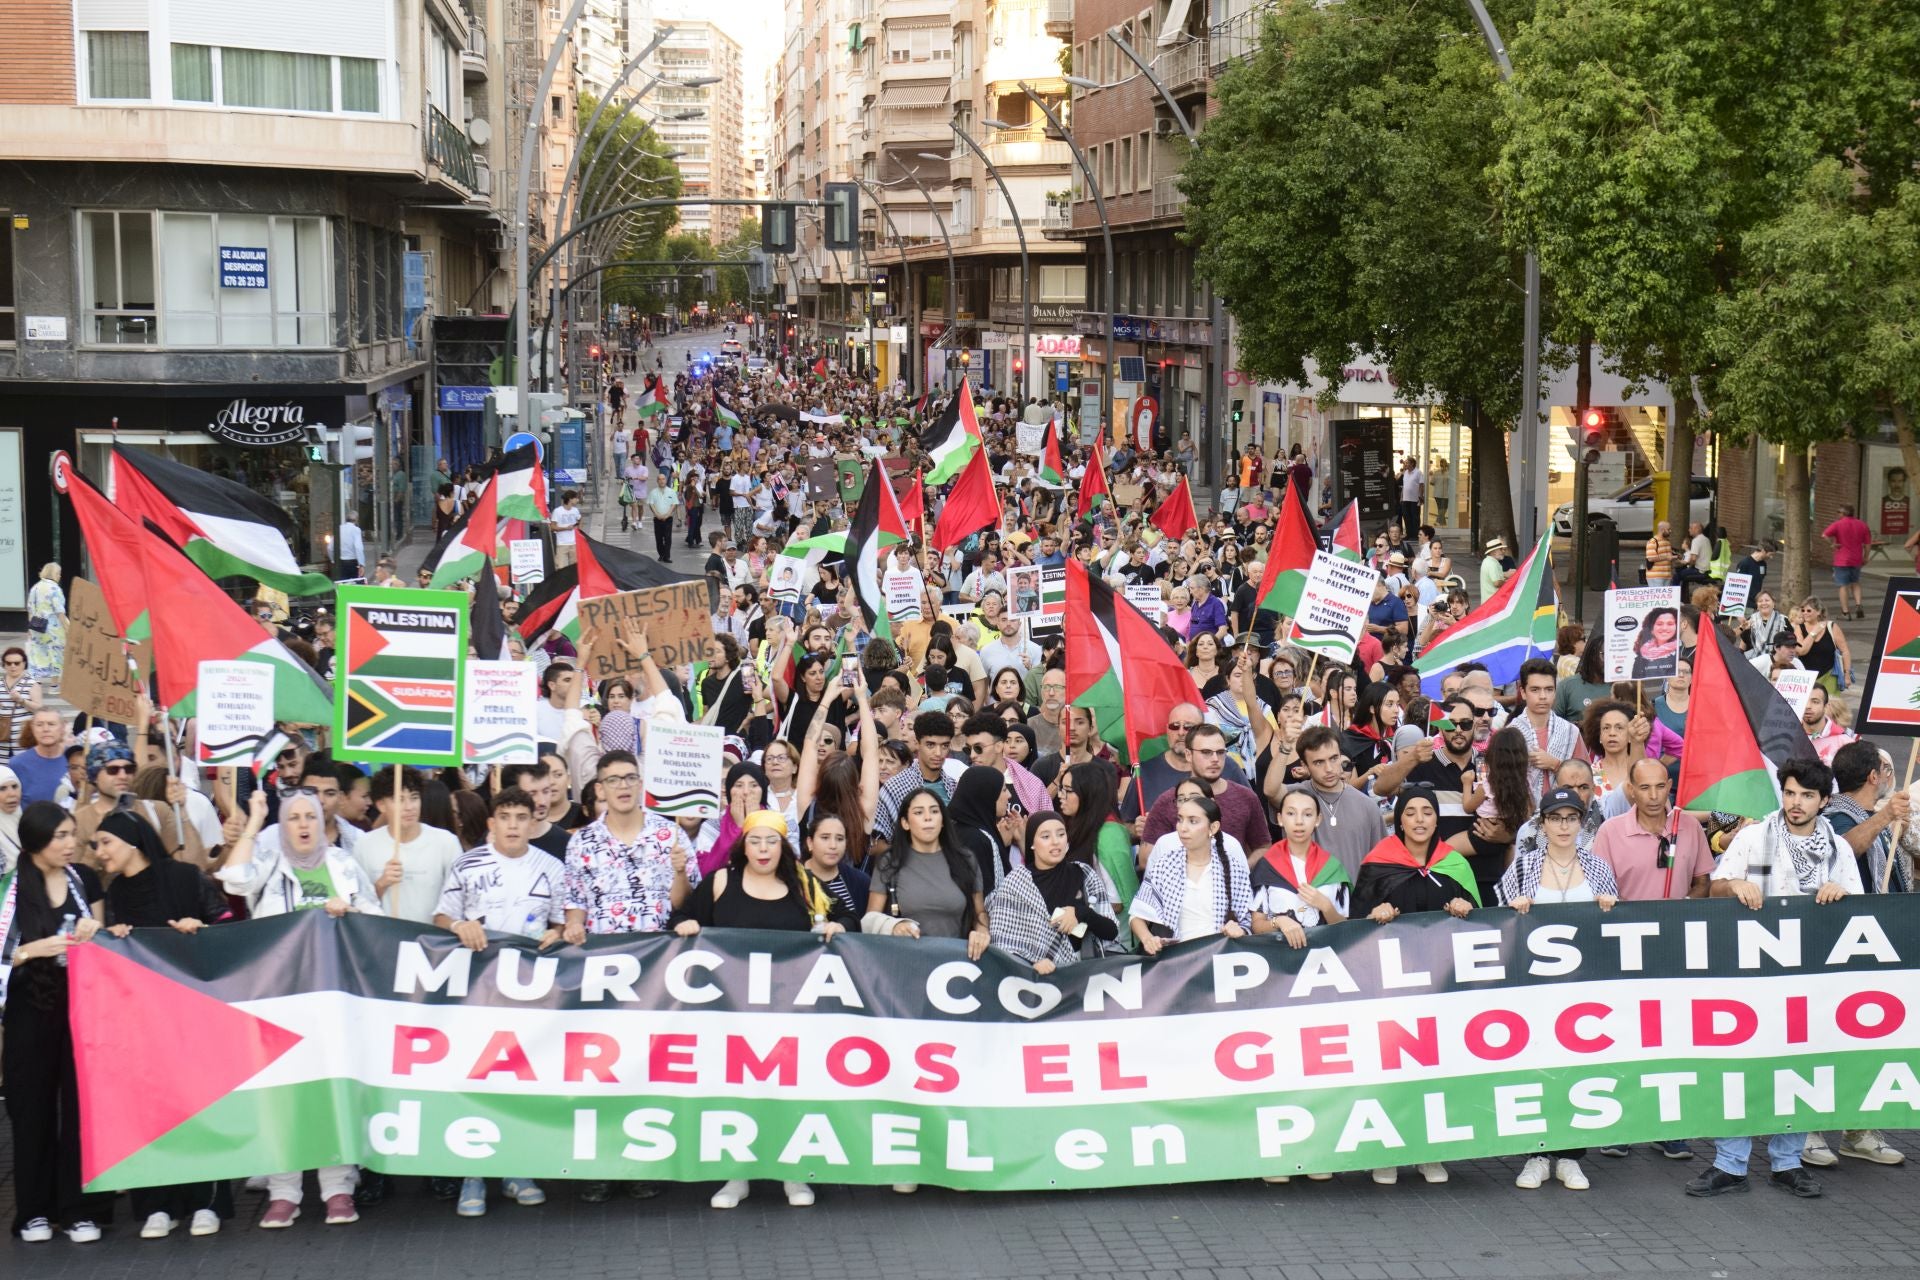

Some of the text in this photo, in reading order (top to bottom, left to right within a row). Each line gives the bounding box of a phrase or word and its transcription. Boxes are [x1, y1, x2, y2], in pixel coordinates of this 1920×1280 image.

[222, 250, 266, 260] SE ALQUILAN
[223, 262, 264, 272] DESPACHOS
[224, 276, 237, 286] 676
[208, 398, 304, 432] Alegría
[1318, 554, 1328, 563] NO
[1340, 562, 1375, 580] LIMPIEZA
[1042, 572, 1066, 580] LESTINA
[1326, 578, 1370, 599] PALESTINOS
[1616, 588, 1673, 596] PRISIONERAS
[1307, 591, 1317, 600] NO
[1323, 598, 1364, 617] GENOCIDIO
[1616, 594, 1673, 602] PALESTINAS
[1619, 600, 1669, 609] LIBERTAD
[367, 611, 454, 628] PALESTINA
[1309, 613, 1349, 632] PALESTINO
[1321, 607, 1351, 623] PUEBLO
[391, 687, 453, 698] SUDÁFRICA
[394, 915, 1901, 1019] MURCIA CON PALESTINA
[391, 990, 1906, 1094] PAREMOS EL GENOCIDIO
[367, 1062, 1920, 1172] de ISRAEL en PALESTINA
